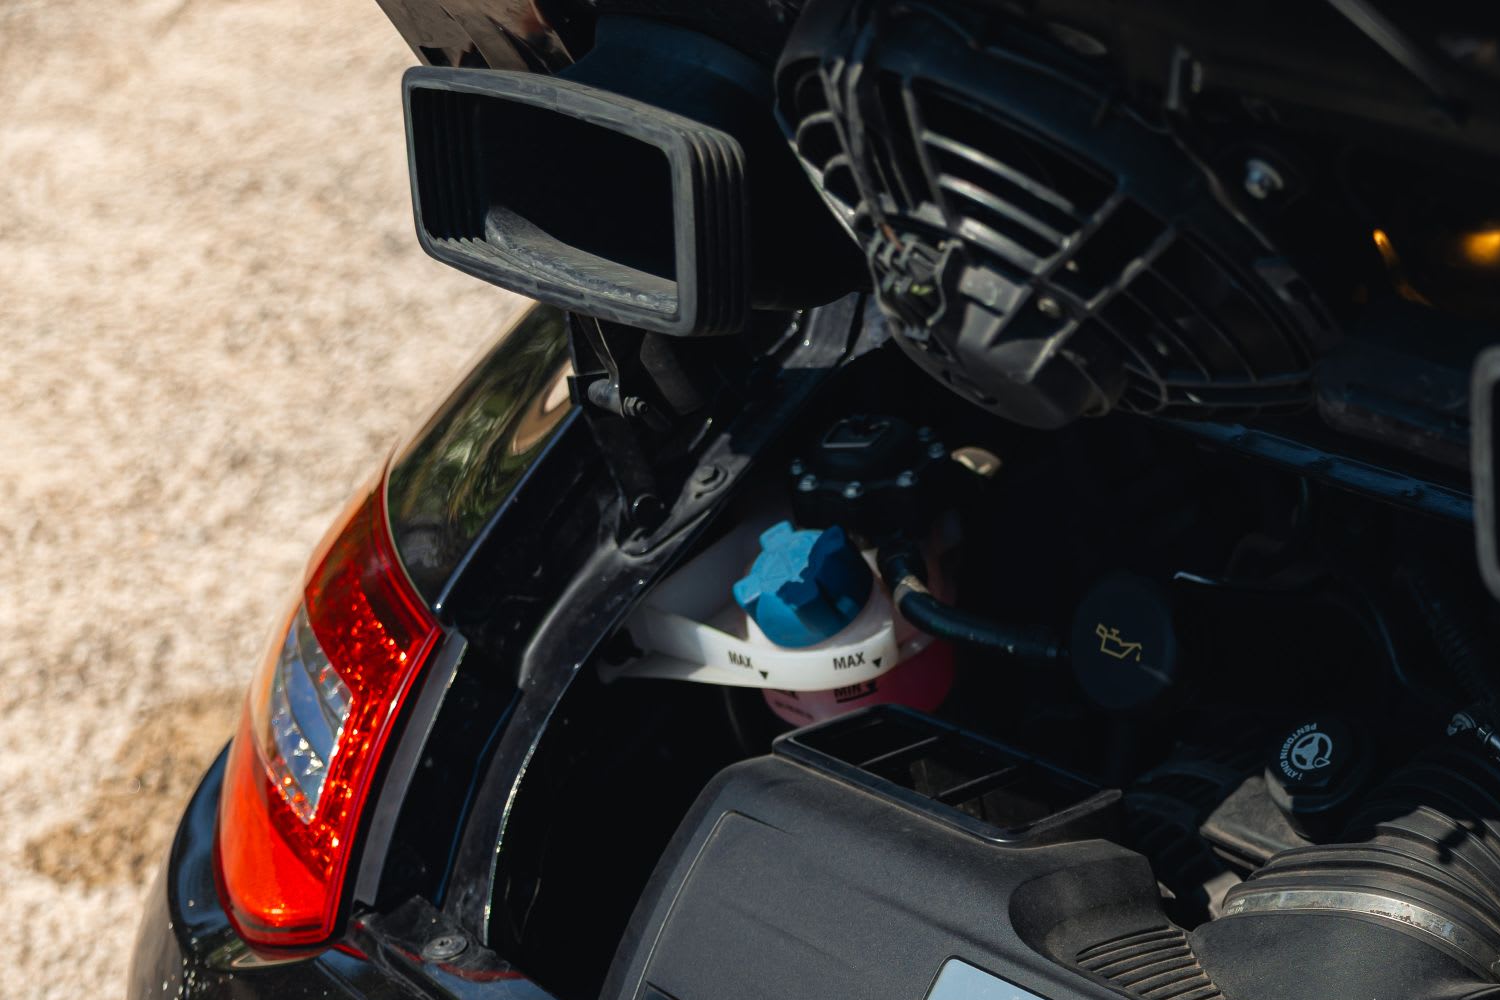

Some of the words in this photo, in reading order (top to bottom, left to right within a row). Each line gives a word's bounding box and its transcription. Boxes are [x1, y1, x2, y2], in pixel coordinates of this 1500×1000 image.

[729, 651, 753, 669] MAX
[833, 652, 866, 671] MAX
[1280, 722, 1318, 760] PENTOSIN
